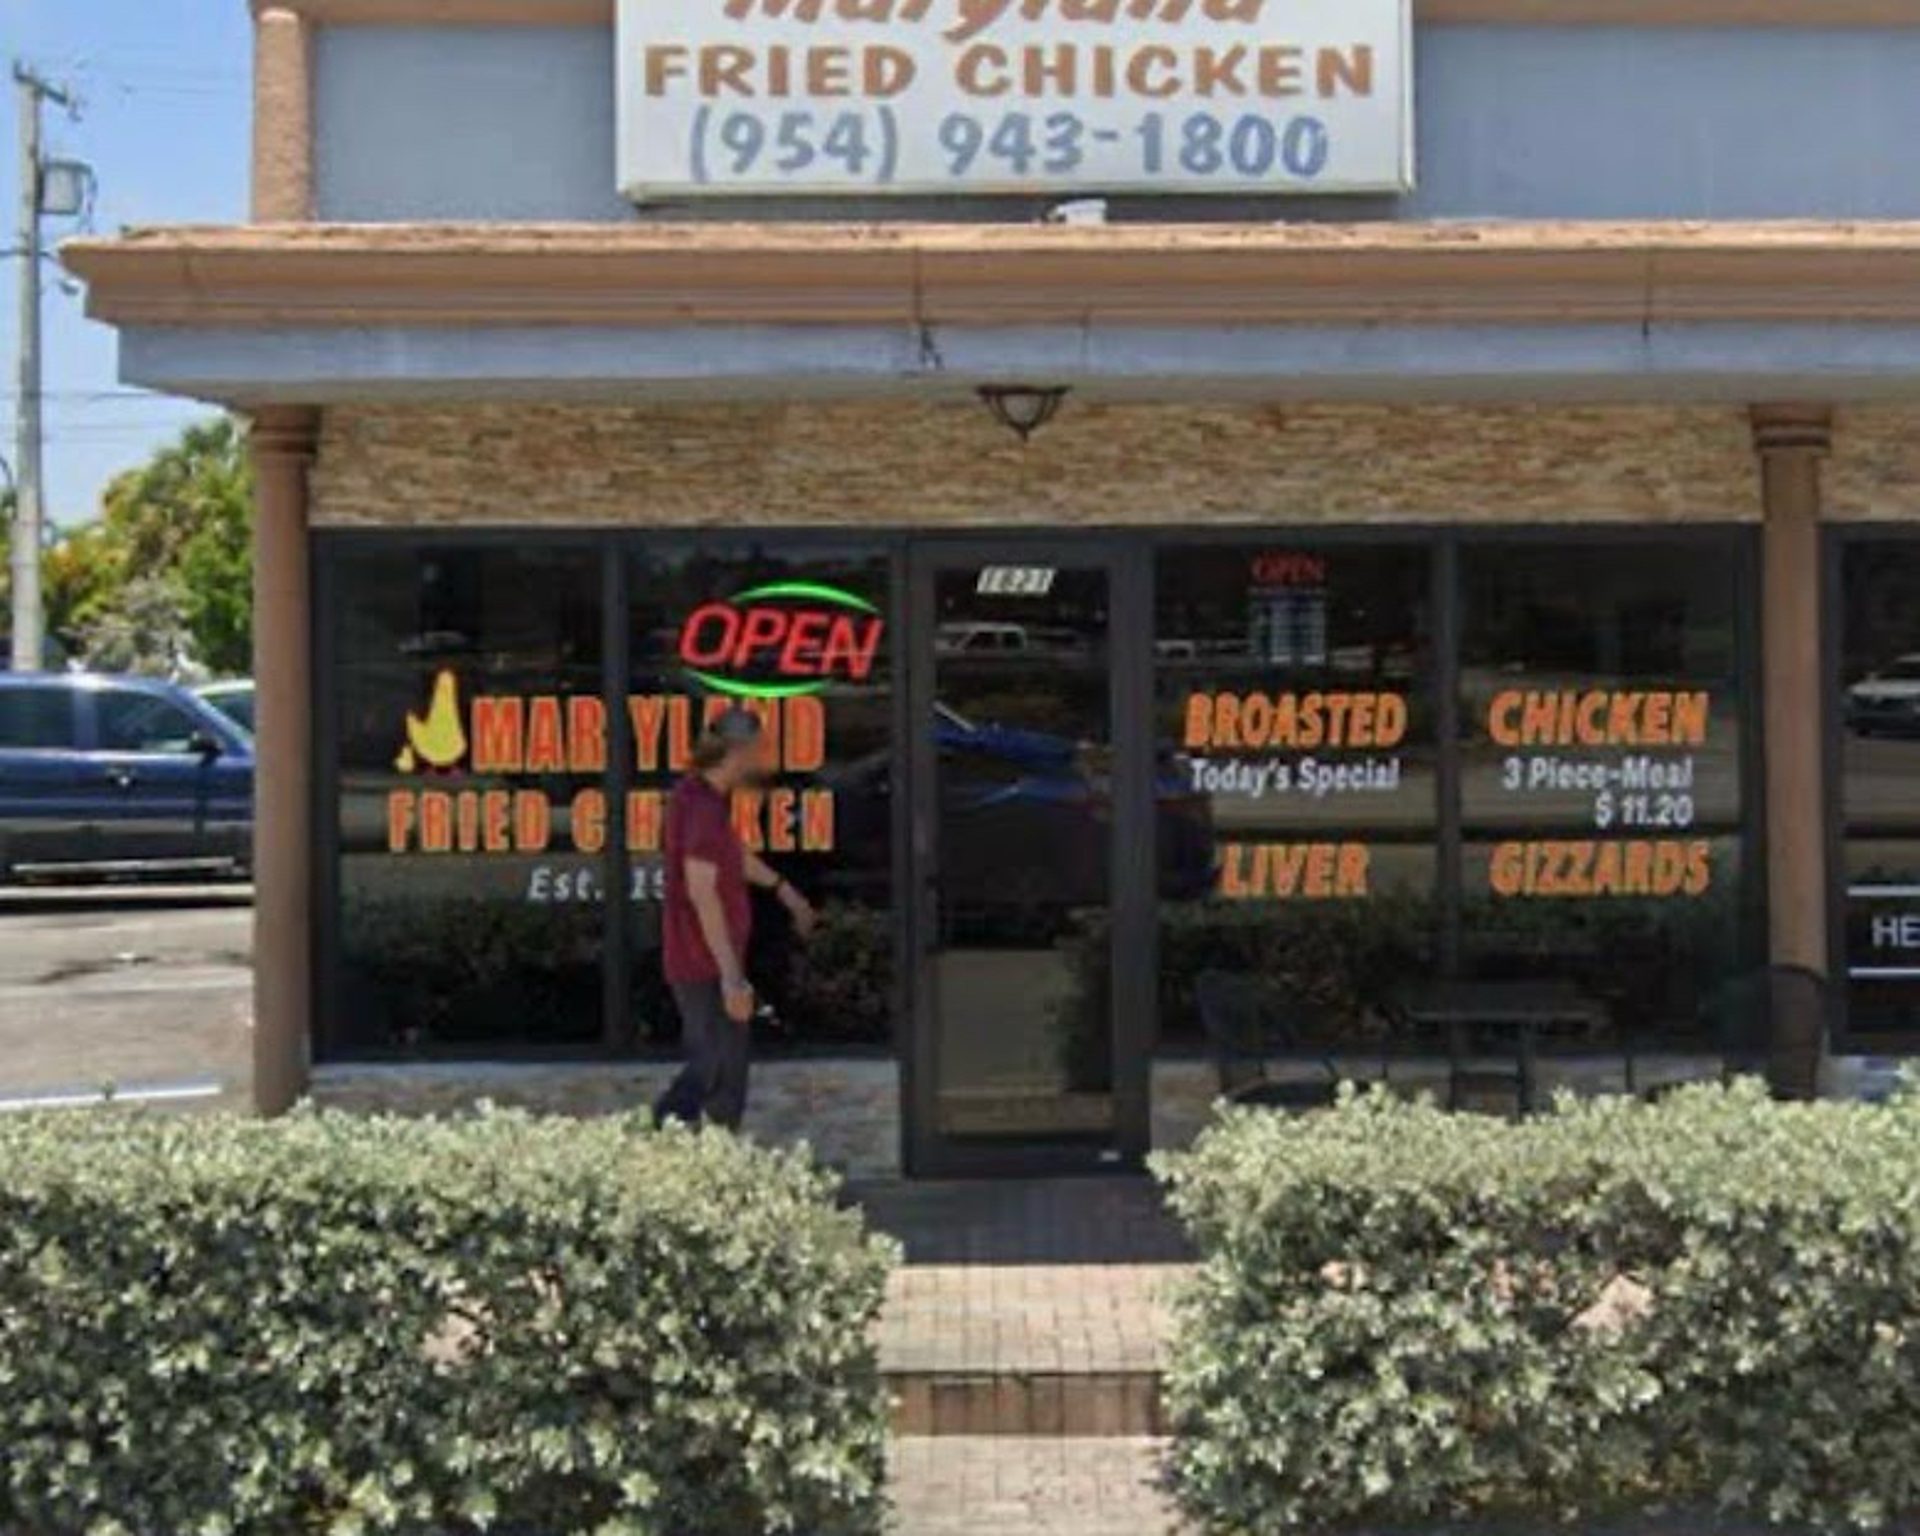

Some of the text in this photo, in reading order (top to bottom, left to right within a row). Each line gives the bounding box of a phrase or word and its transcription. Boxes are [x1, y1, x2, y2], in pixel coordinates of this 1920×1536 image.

[644, 44, 1373, 97] FRIED CHICKEN
[690, 106, 1329, 182] (954) 943-1800
[679, 603, 882, 678] OPEN
[1184, 692, 1406, 748] BROASTED
[1488, 691, 1708, 746] CHICKEN
[1191, 757, 1399, 798] Today's Special
[1503, 757, 1521, 789] 3
[389, 789, 833, 852] FRIED CHKEN
[1595, 792, 1694, 828] $ 11.20
[528, 867, 602, 900] Est.
[1222, 843, 1367, 897] LIVER
[1489, 841, 1709, 894] GIZZARDS
